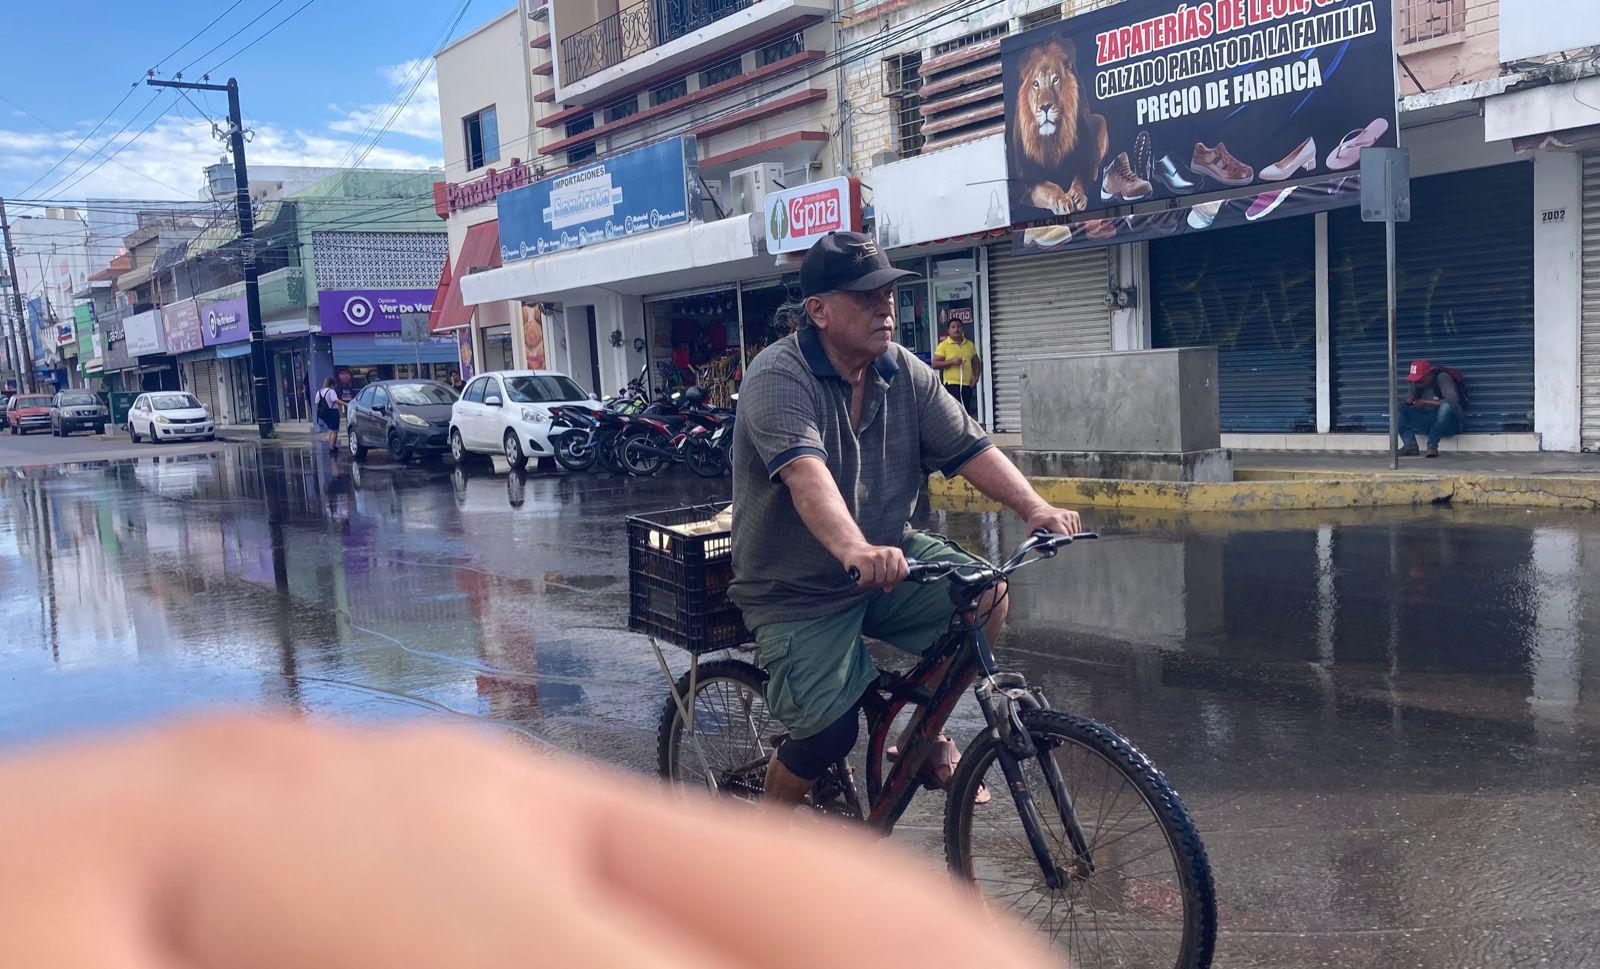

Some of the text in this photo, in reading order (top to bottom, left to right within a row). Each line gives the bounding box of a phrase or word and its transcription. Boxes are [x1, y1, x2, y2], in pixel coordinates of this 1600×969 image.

[1096, 3, 1214, 66] ZAPATERÍAS
[1216, 0, 1246, 34] DE
[1096, 1, 1377, 100] CALZADO PARA TODA LA FAMILIA
[1136, 57, 1323, 125] PRECIO DE FABRICA
[553, 166, 605, 190] IMPORTACIONES
[791, 197, 839, 235] Gpna
[1542, 209, 1566, 221] 2002
[379, 304, 398, 313] Ver
[399, 304, 414, 314] De
